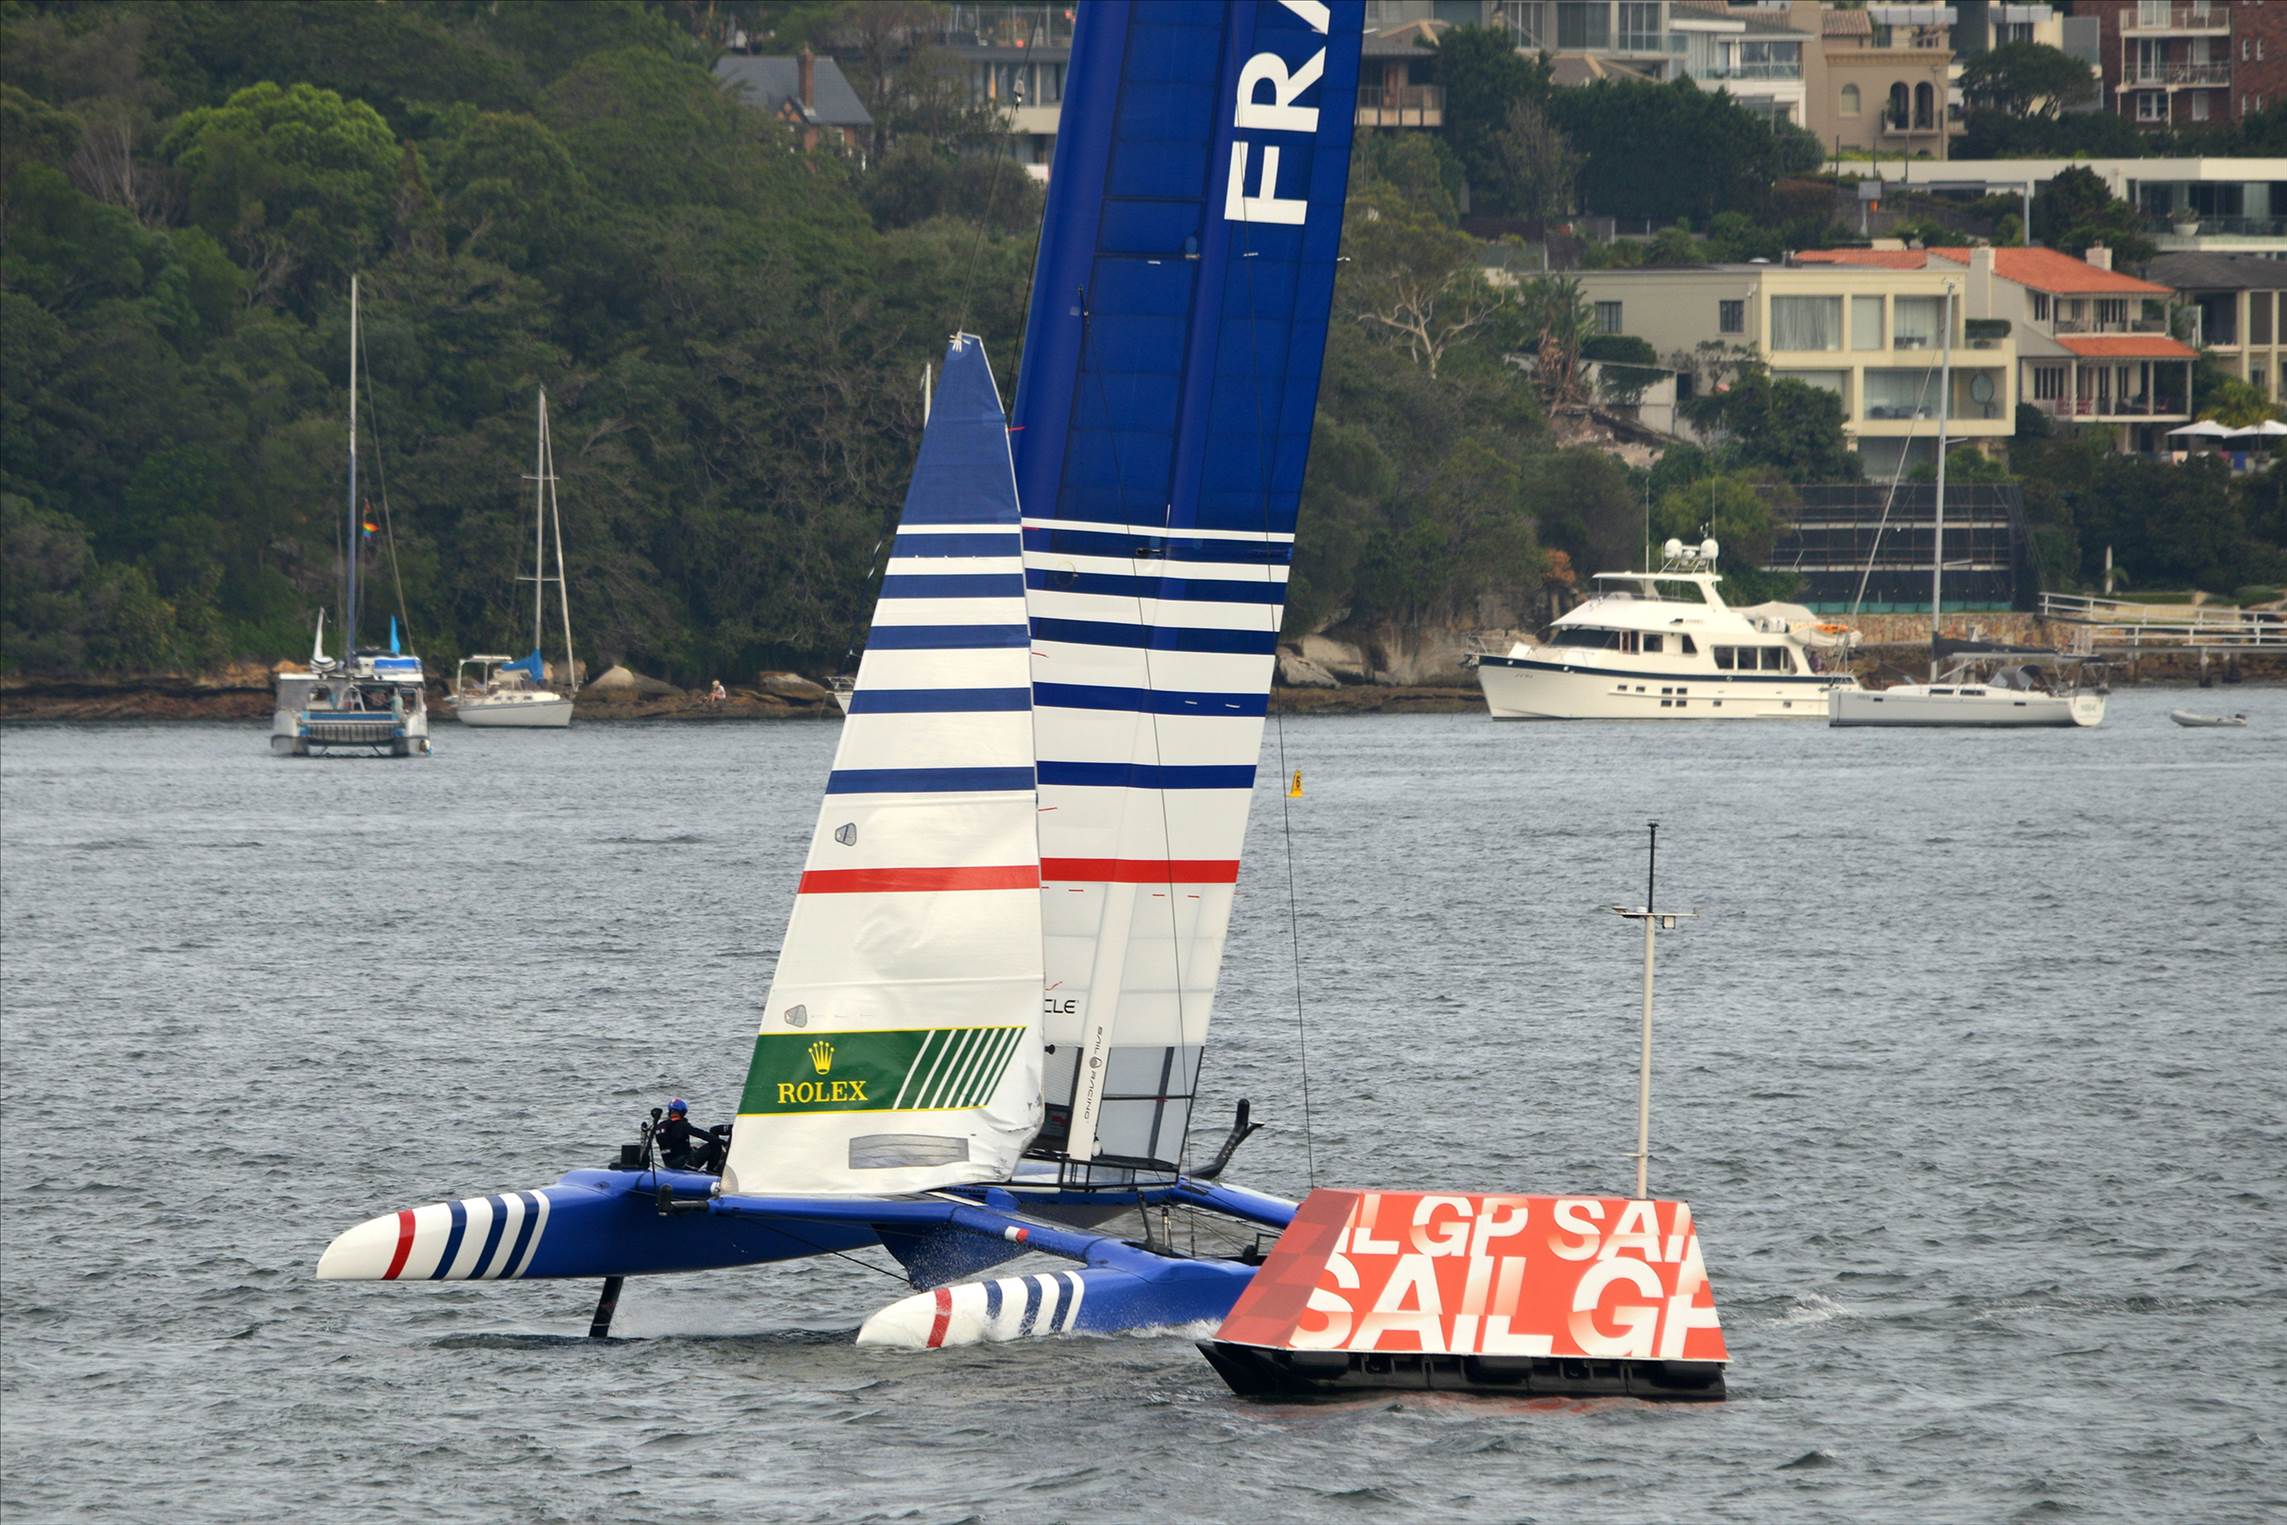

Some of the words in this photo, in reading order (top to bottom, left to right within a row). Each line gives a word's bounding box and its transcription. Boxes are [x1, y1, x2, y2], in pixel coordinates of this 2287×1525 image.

[777, 1080, 868, 1104] ROLEX
[1409, 1196, 1528, 1258] GP
[1289, 1252, 1553, 1354] SAIL
